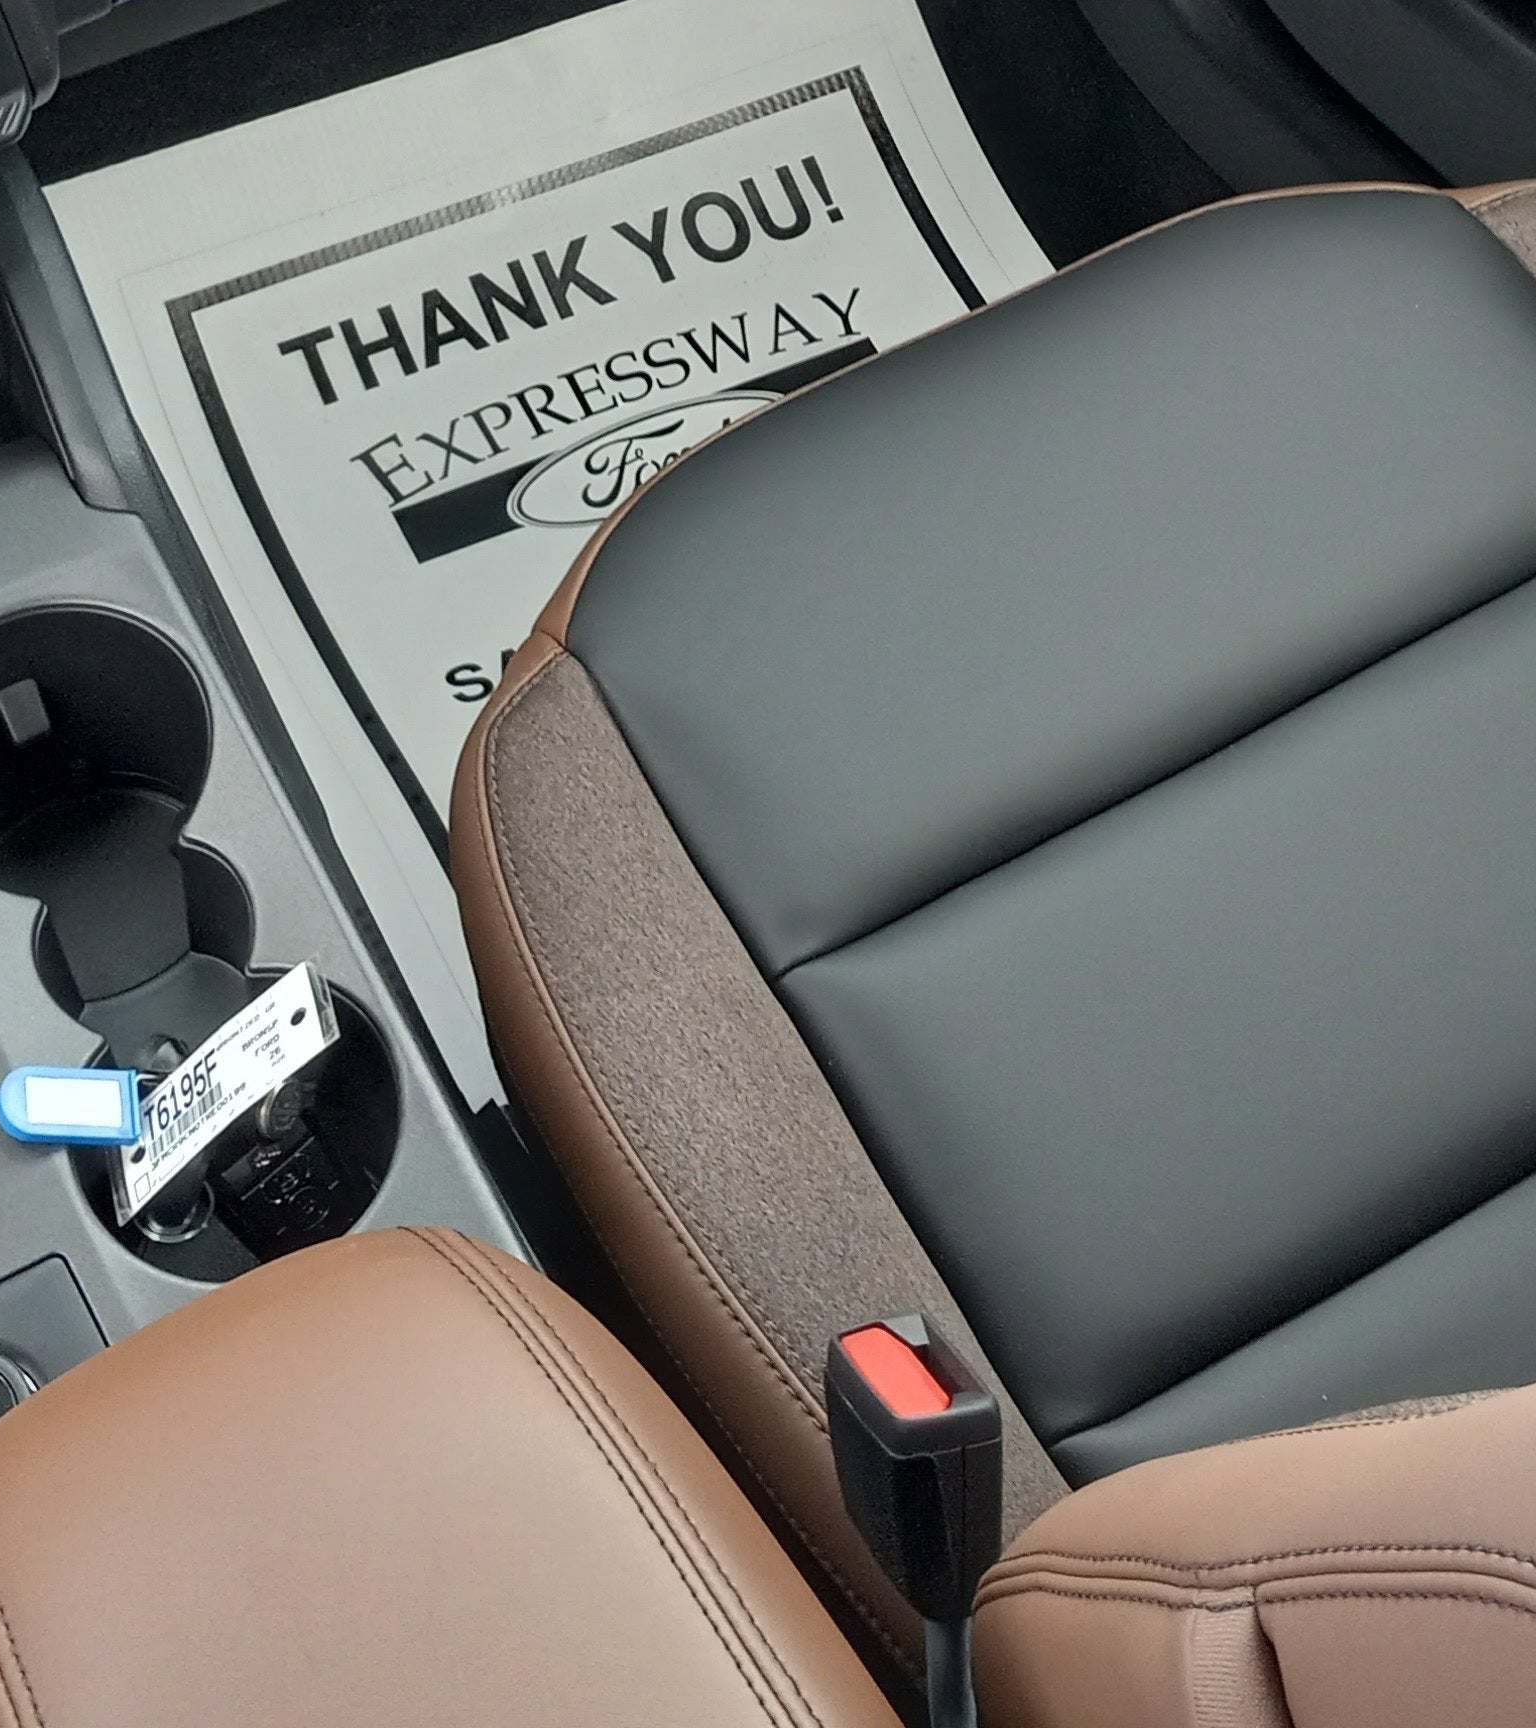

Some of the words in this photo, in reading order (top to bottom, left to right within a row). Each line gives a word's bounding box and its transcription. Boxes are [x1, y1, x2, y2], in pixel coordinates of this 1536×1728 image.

[278, 237, 617, 406] THANK
[611, 155, 847, 285] YOU!
[350, 287, 863, 507] EXPRESSWAY
[144, 1048, 217, 1140] T6195F
